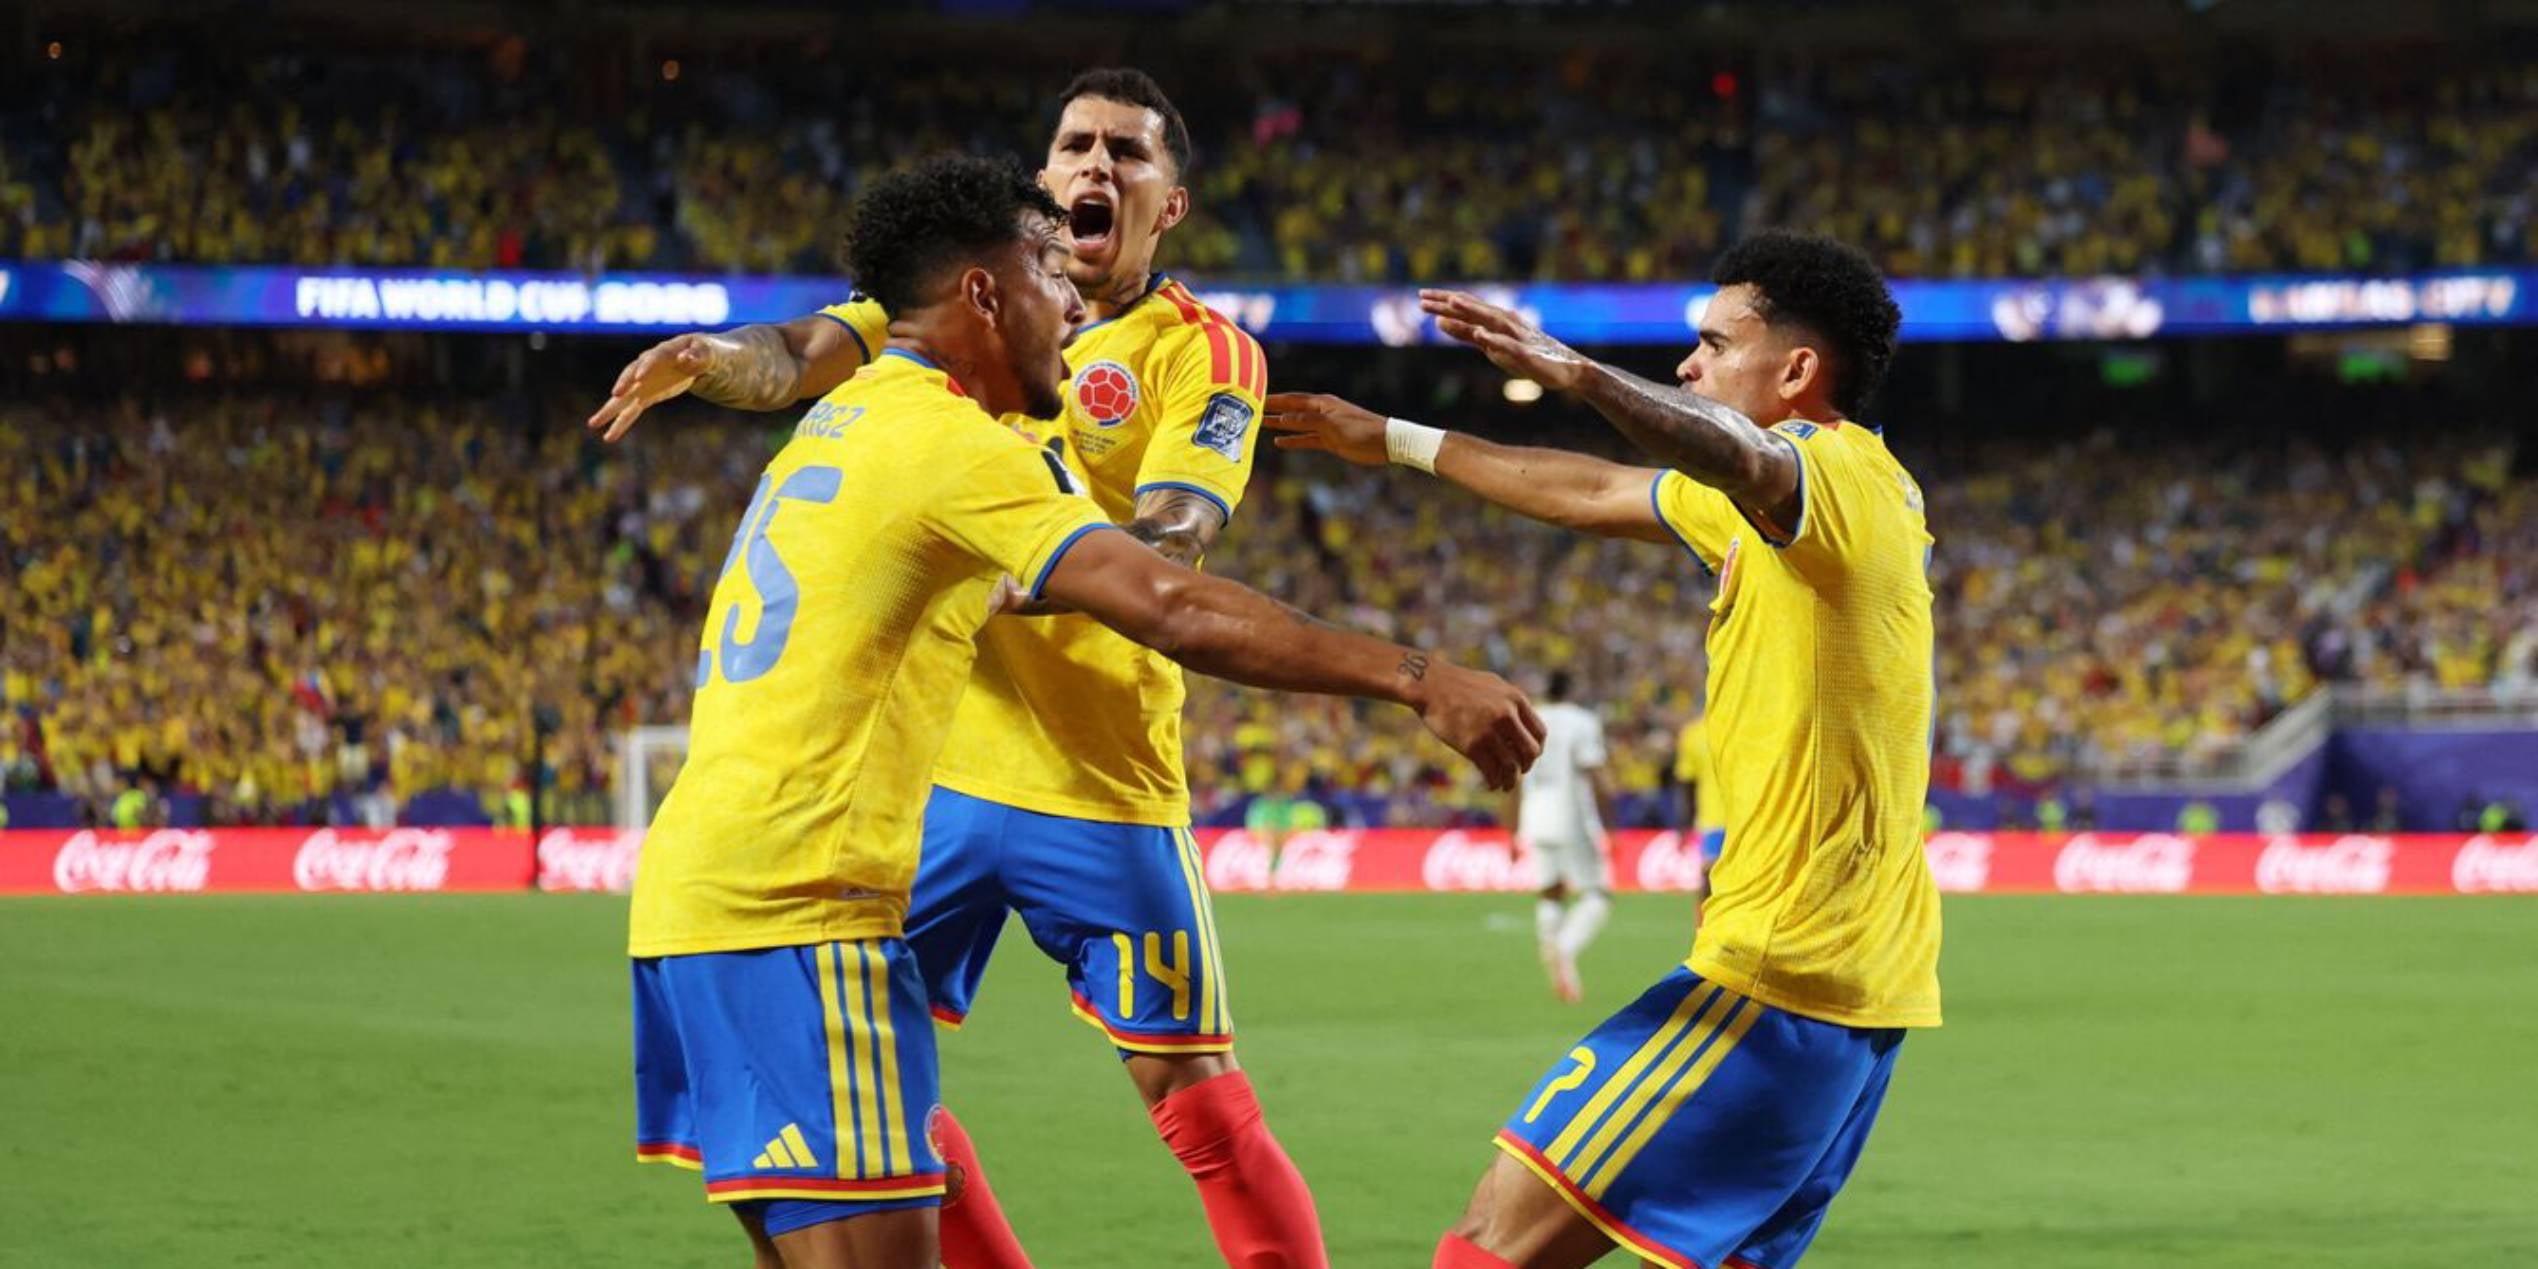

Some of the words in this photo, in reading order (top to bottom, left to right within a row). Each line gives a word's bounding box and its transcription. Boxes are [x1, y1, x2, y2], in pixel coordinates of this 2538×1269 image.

[297, 277, 380, 319] FIFA
[378, 278, 518, 321] WORLD
[517, 279, 591, 323] CUP
[53, 828, 216, 893] Coca-Cola
[293, 827, 456, 892] Coca-Cola
[2054, 831, 2197, 893] Coca-Cola
[2255, 833, 2395, 893] Coca-Cola
[1112, 930, 1190, 1020] 14
[1524, 1046, 1596, 1124] 7
